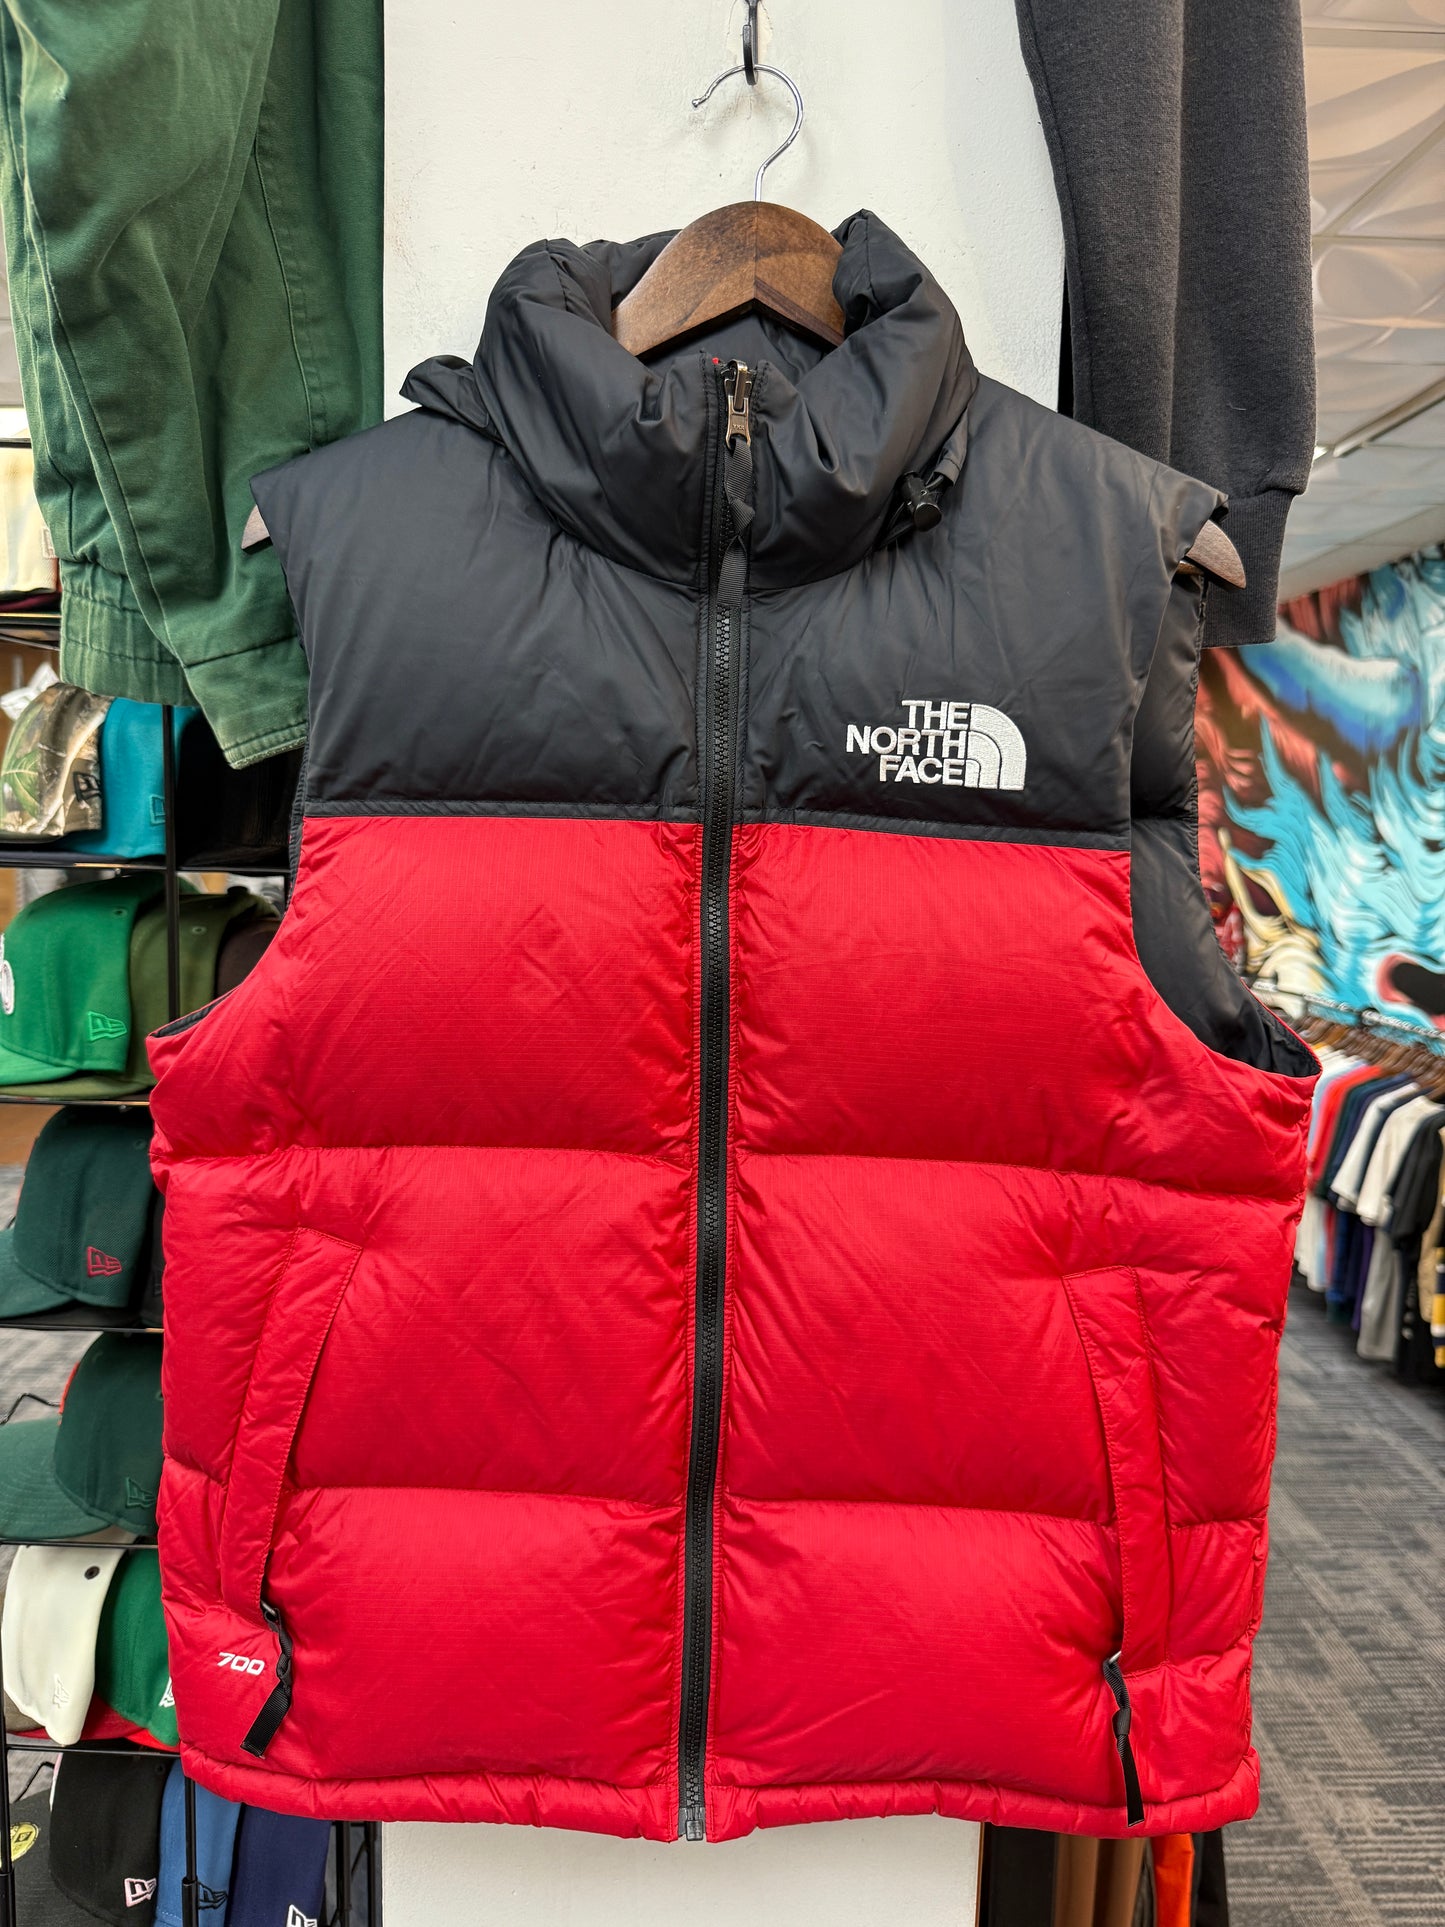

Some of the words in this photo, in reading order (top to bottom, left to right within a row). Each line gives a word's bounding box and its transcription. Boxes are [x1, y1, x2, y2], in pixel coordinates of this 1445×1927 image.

[901, 700, 970, 731] THE
[846, 724, 966, 759] NORTH
[879, 754, 965, 786] FACE
[217, 1652, 265, 1676] 700
